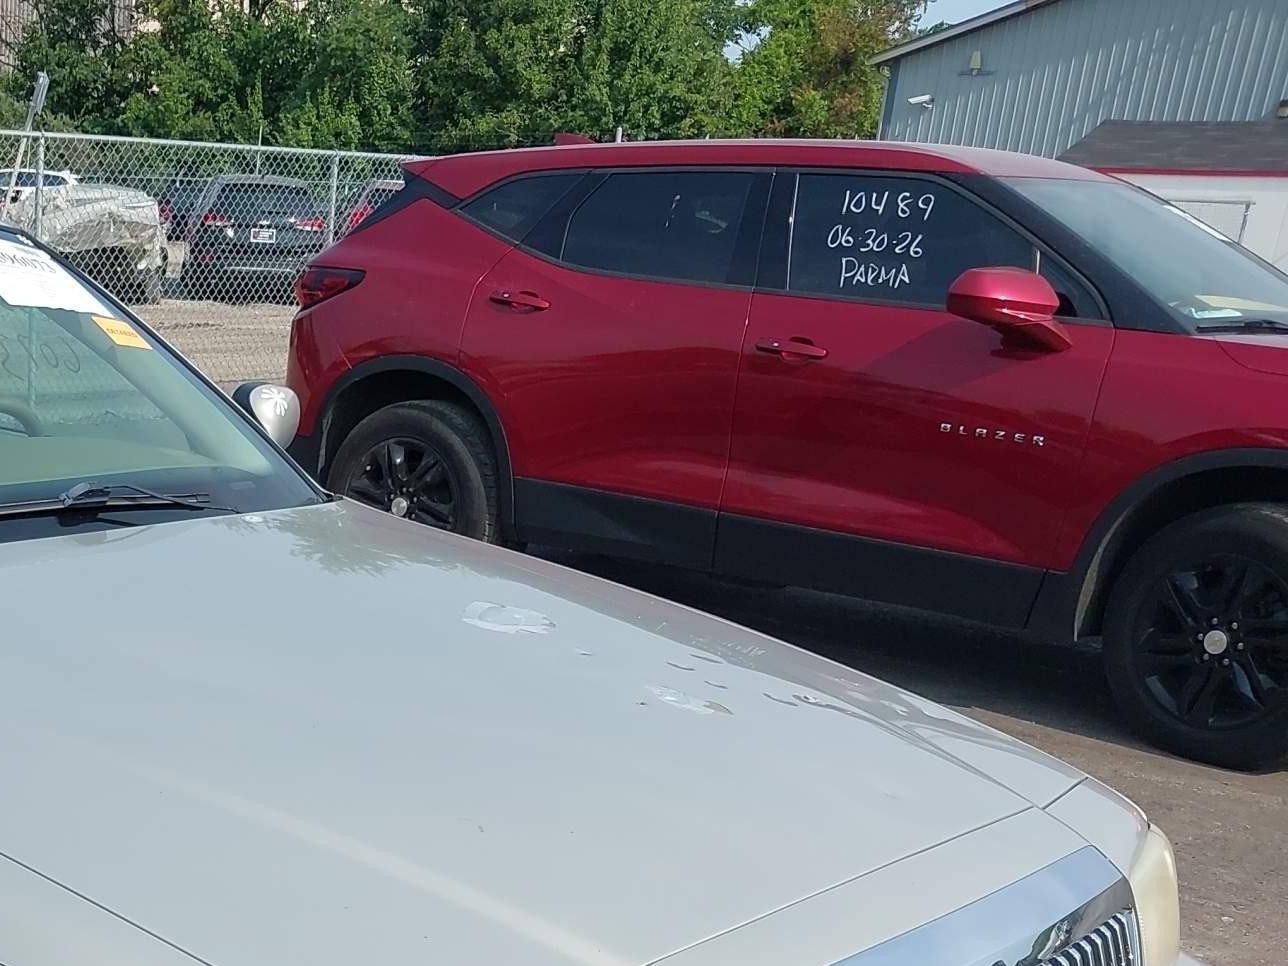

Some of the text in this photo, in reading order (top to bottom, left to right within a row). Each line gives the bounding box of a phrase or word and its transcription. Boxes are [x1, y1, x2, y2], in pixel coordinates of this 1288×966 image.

[842, 190, 935, 221] 10489
[839, 257, 910, 289] PARMA
[940, 423, 1045, 446] BLAZER
